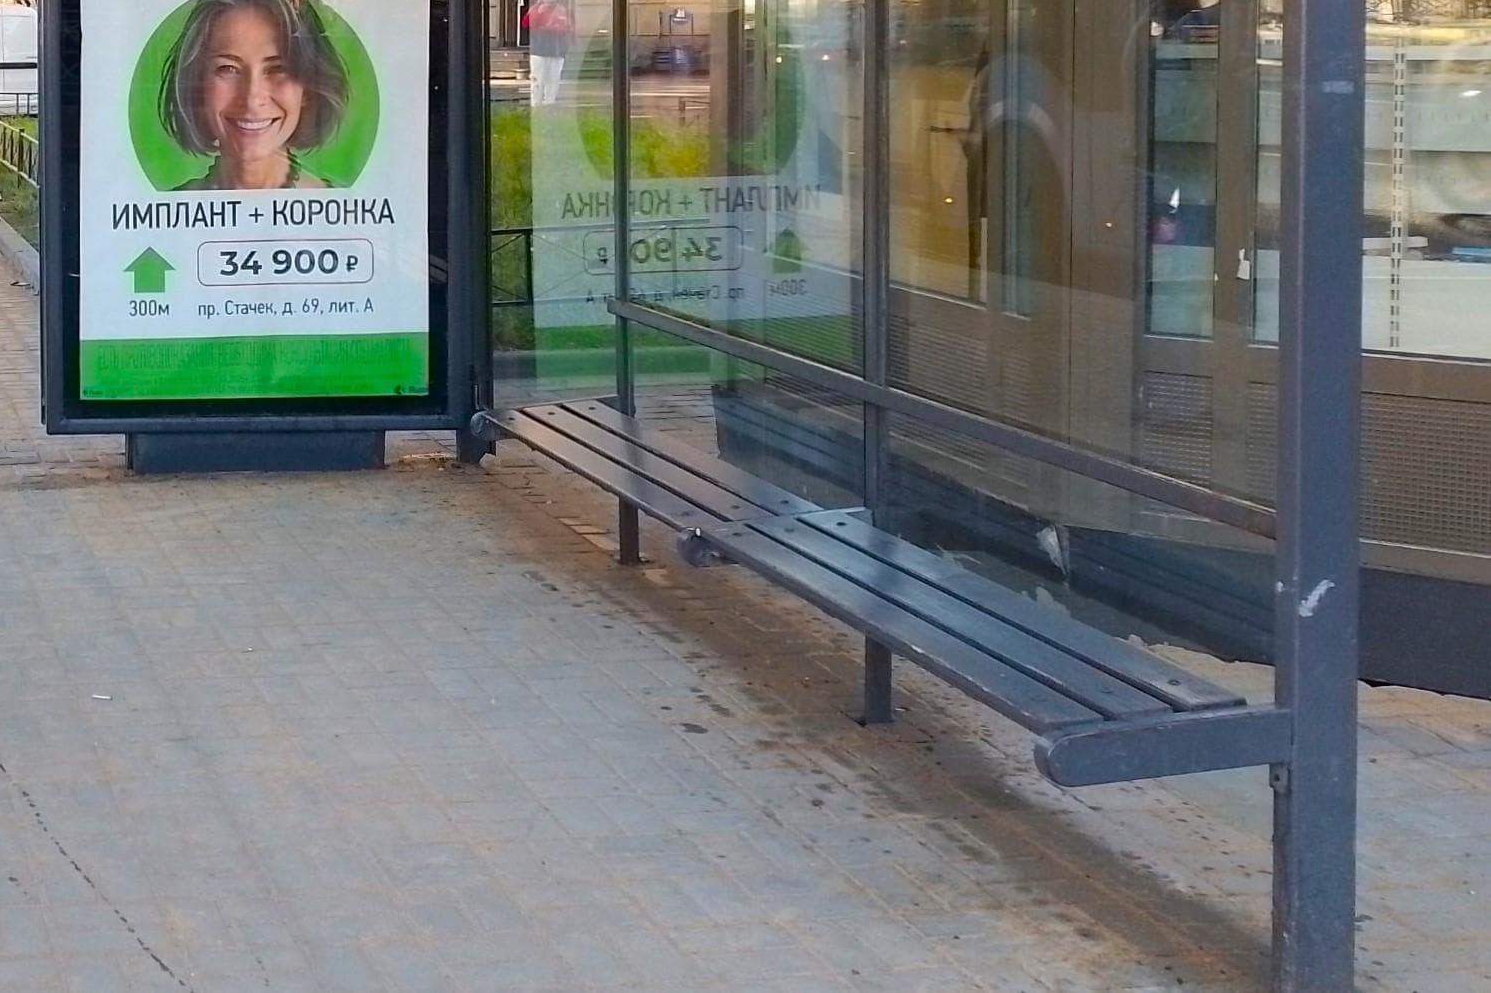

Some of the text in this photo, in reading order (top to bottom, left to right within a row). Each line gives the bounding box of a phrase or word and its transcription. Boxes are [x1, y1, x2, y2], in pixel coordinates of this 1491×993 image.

[112, 197, 395, 230] ИМПЛАНТ + КОРОНКА
[219, 250, 262, 276] 34
[272, 248, 339, 275] 900
[128, 300, 170, 316] 300м
[198, 298, 374, 320] пр. Стачек, д. 69, лит. А
